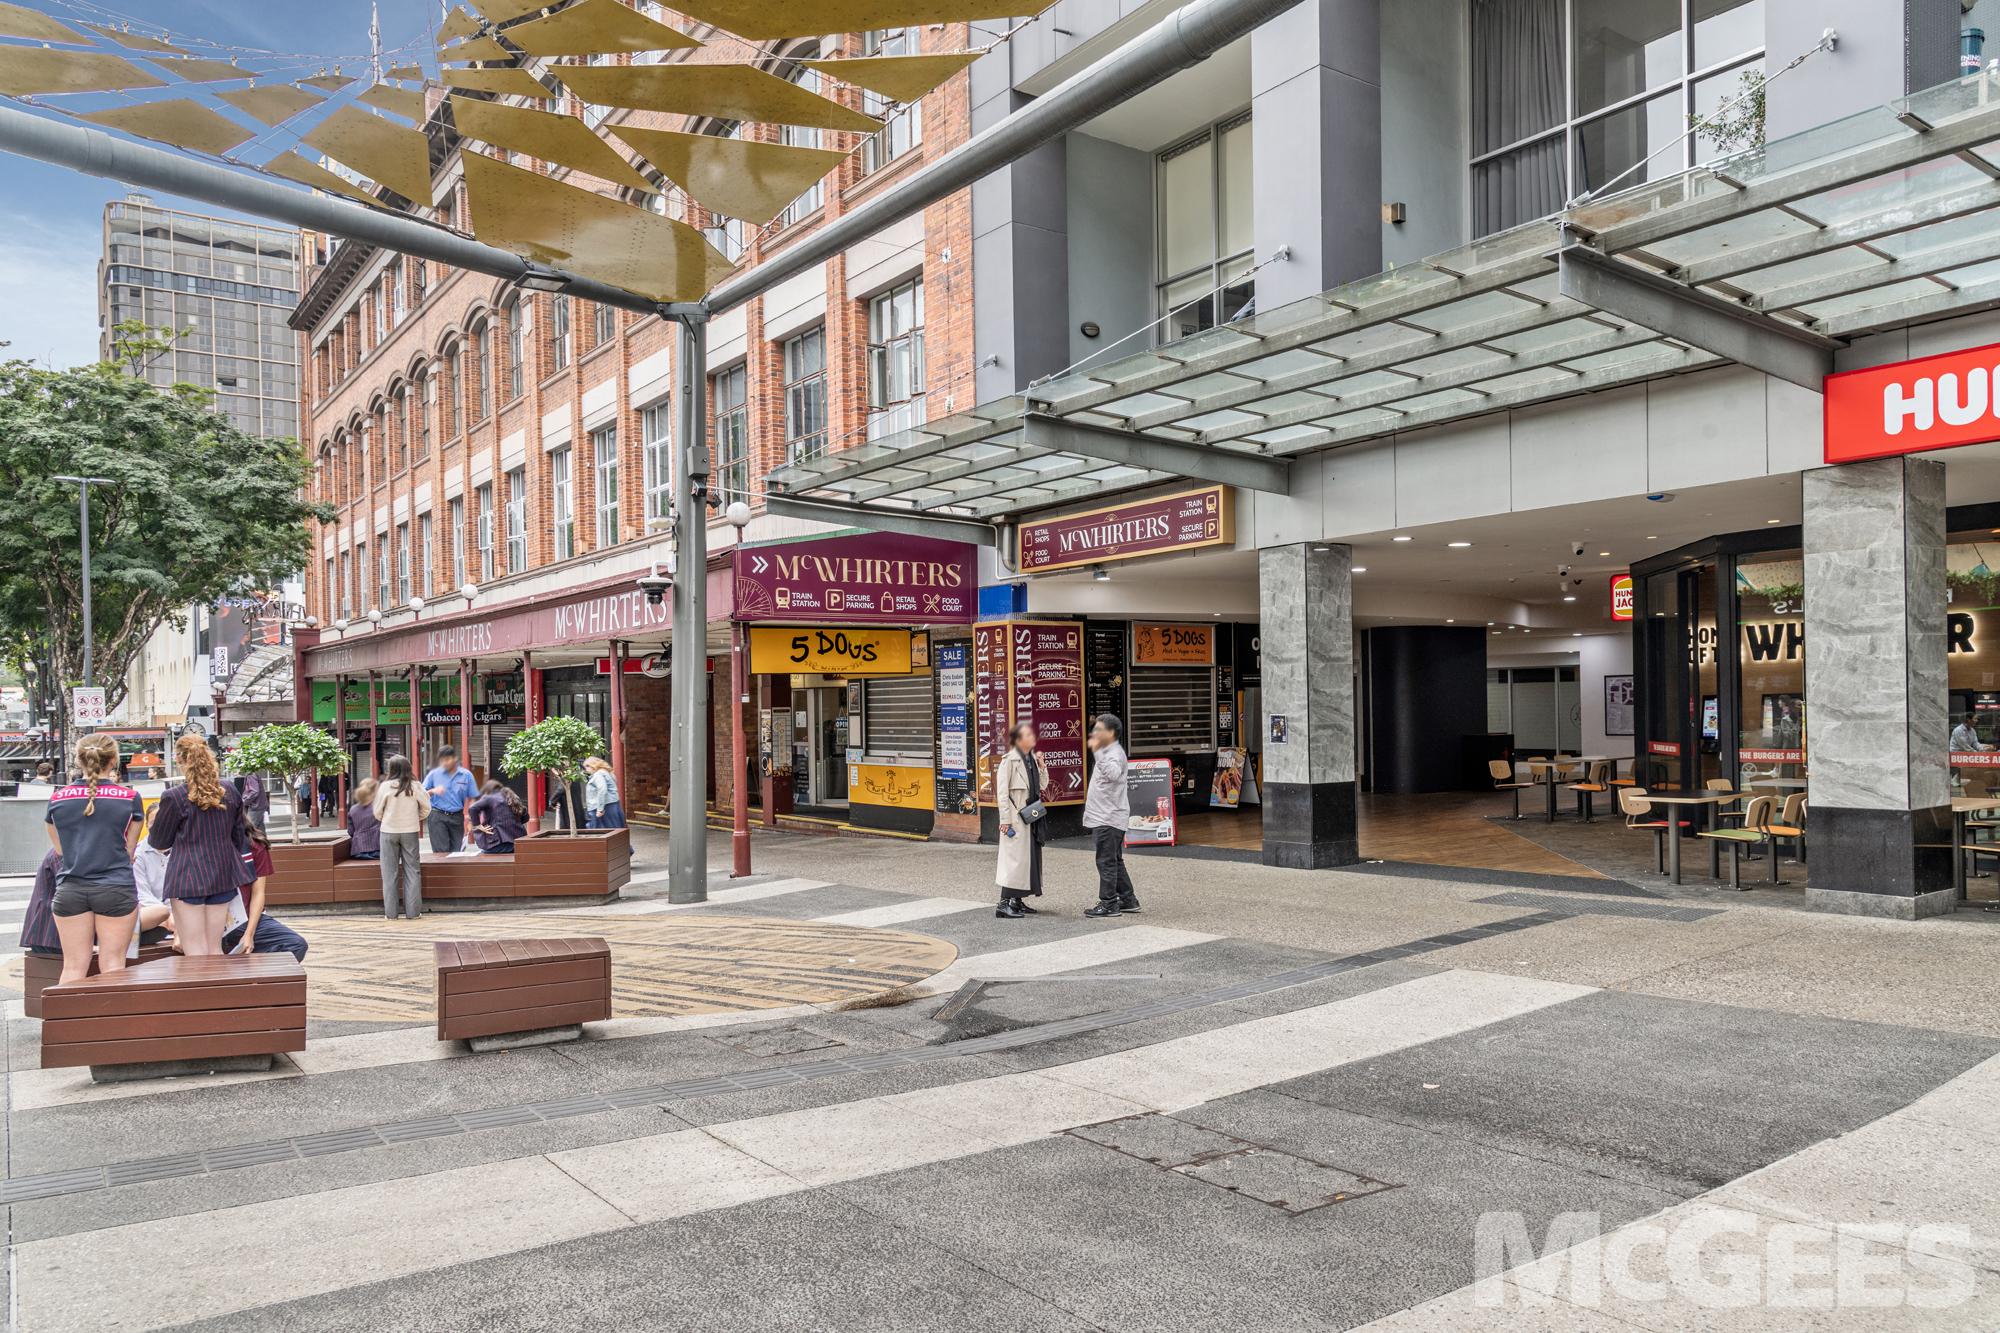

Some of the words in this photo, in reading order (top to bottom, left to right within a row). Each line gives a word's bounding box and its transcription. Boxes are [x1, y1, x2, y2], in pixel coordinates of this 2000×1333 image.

[1185, 499, 1203, 509] TRAIN
[1179, 507, 1203, 518] STATION
[1034, 528, 1049, 537] RETAIL
[1181, 523, 1203, 533] SECURE
[1059, 515, 1170, 553] McWHIRTERS
[1178, 531, 1203, 541] PARKING
[1034, 536, 1050, 544] SHOPS
[1034, 549, 1048, 557] FOOD
[1034, 556, 1050, 564] COURT
[775, 554, 961, 588] McWHIRTERS
[792, 592, 813, 600] TRAIN
[792, 599, 820, 608] STATION
[846, 601, 875, 609] PARKING
[942, 597, 960, 605] FOOD
[896, 603, 917, 611] SHOPS
[942, 604, 962, 612] COURT
[428, 622, 492, 657] McWHIRTERS
[1162, 628, 1172, 646] 5
[1173, 629, 1206, 646] DOGS
[790, 636, 809, 662] 5
[815, 631, 878, 662] DOGS
[1037, 642, 1065, 650] STATION
[943, 650, 962, 661] SALE
[1038, 663, 1062, 671] SECURE
[1038, 670, 1066, 678] PARKING
[1039, 701, 1060, 709] SHOPS
[425, 712, 460, 723] Tobacco
[474, 711, 502, 723] Cigars
[942, 716, 965, 726] LEASE
[1045, 750, 1079, 759] ESIDENTIAL
[1739, 751, 1752, 760] THE
[1753, 752, 1785, 760] BURGERS
[1786, 752, 1801, 760] ARE
[1045, 758, 1082, 766] PARTMENTS
[1951, 755, 1990, 764] BURGERS
[57, 787, 89, 798] STATE
[96, 787, 128, 797] HIGH
